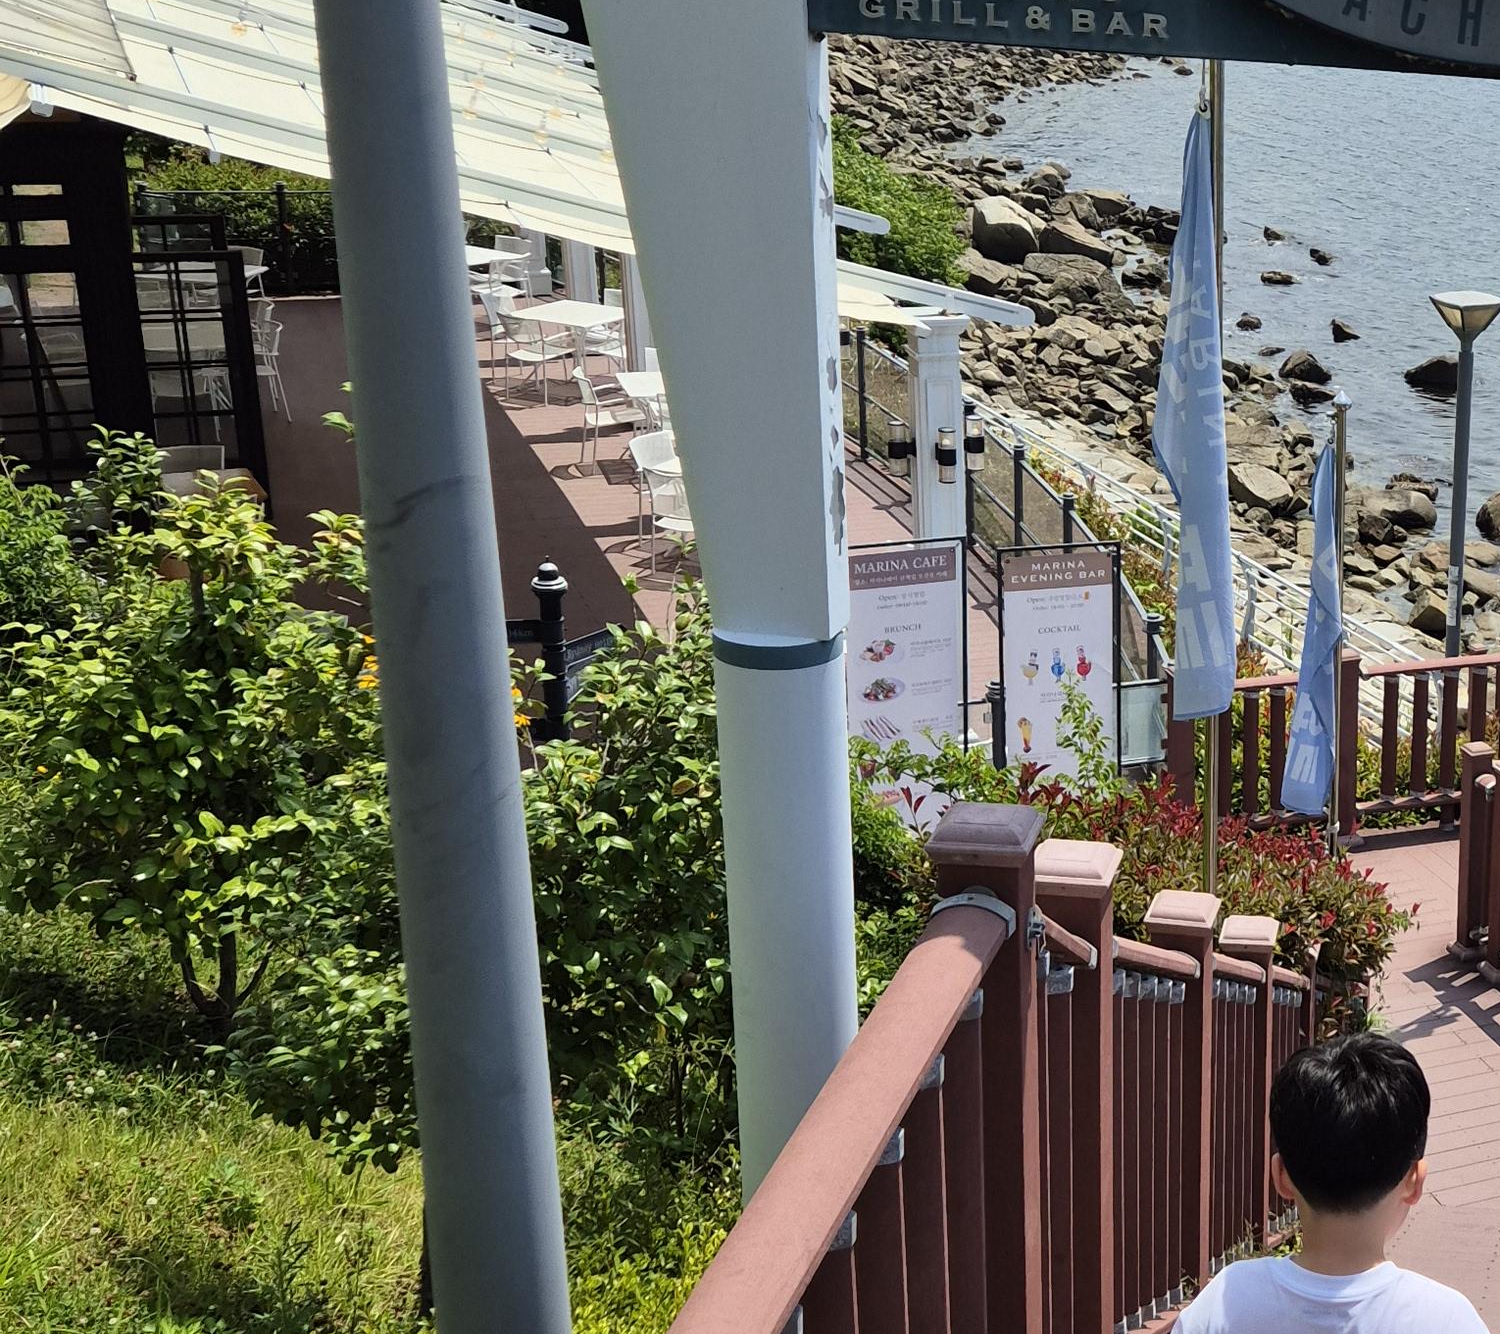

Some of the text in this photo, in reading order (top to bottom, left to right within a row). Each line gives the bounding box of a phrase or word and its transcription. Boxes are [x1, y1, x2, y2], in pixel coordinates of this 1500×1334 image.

[1025, 5, 1051, 30] &
[1071, 8, 1169, 39] BAR
[854, 555, 948, 574] MARINA CAFE
[1031, 560, 1085, 571] MARINA
[1011, 569, 1106, 584] EVENING BAR
[884, 623, 921, 634] BRUNCH
[1038, 624, 1081, 635] COCKTAIL
